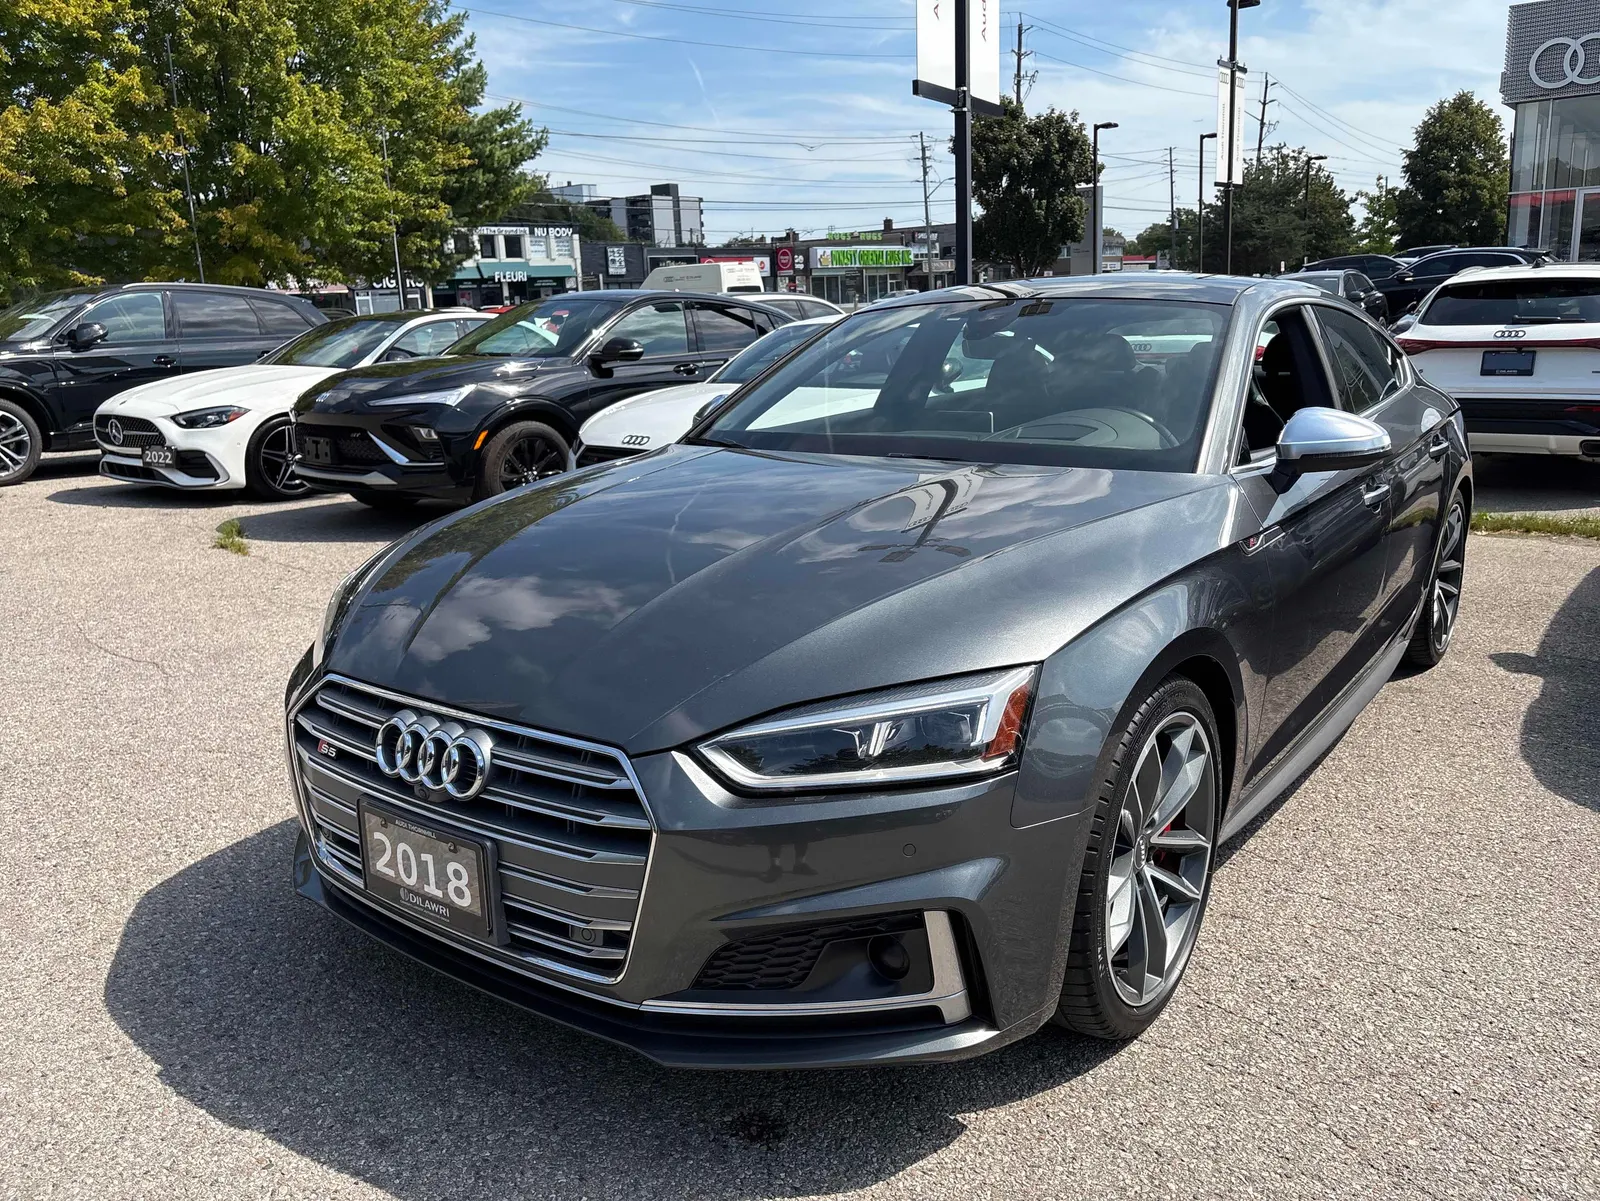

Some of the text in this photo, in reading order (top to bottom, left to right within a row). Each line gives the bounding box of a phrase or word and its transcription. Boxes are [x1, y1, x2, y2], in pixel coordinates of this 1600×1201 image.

[534, 227, 573, 237] NU BODY
[860, 232, 883, 241] RUGS
[831, 250, 858, 267] DYNASTY
[858, 249, 885, 266] ORIENTAL
[494, 271, 527, 283] FLEURI
[145, 450, 173, 464] 2022
[321, 743, 337, 757] S5
[373, 831, 472, 907] 2018
[409, 892, 450, 917] DILAWRI
